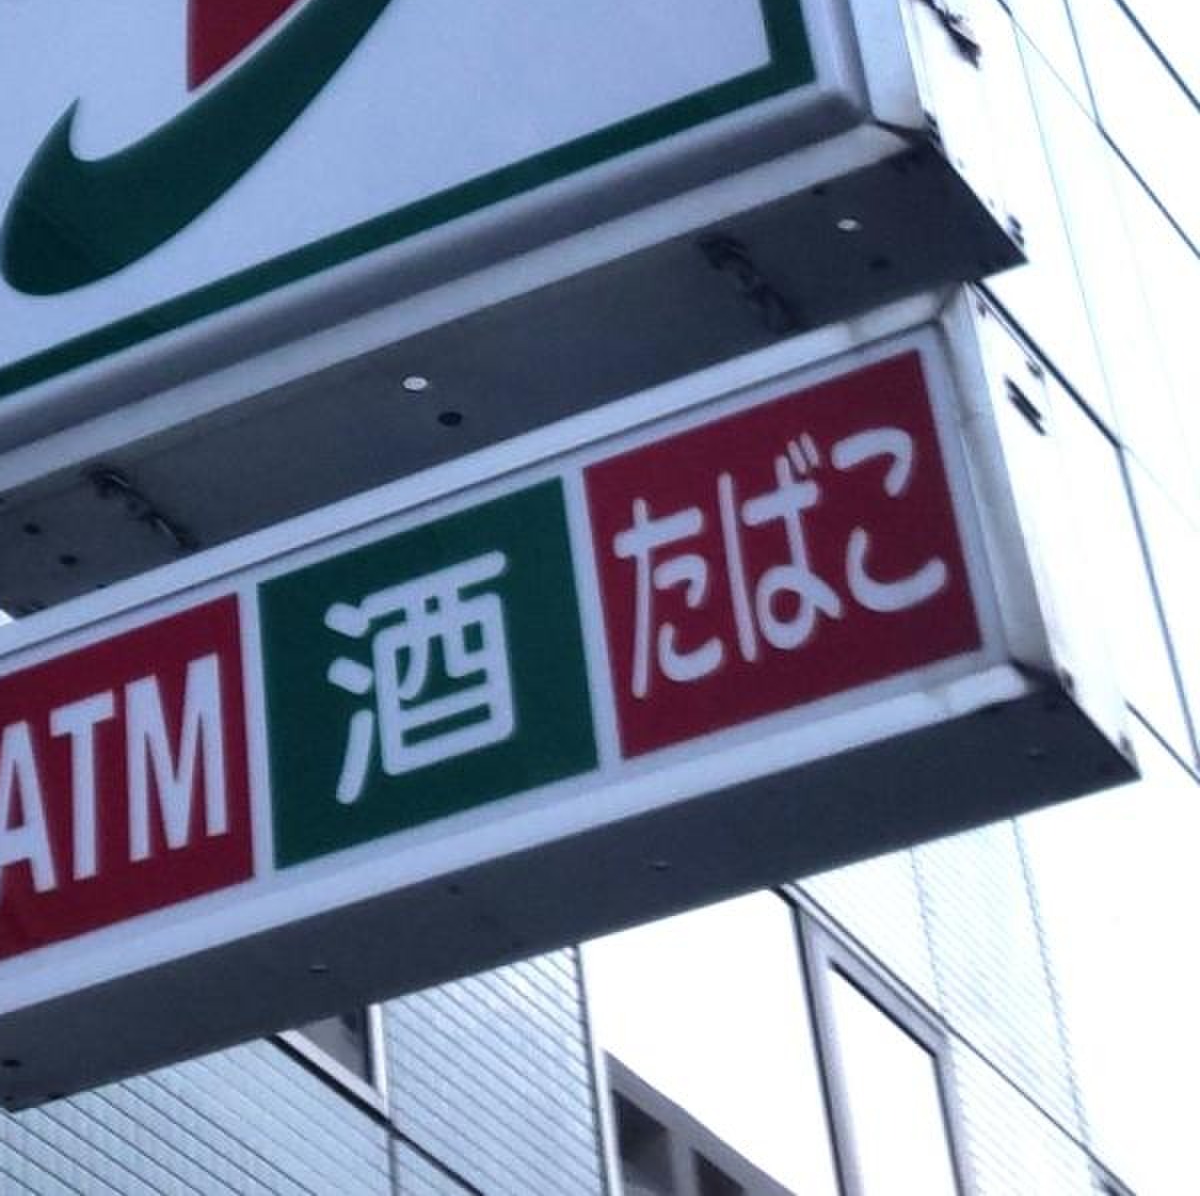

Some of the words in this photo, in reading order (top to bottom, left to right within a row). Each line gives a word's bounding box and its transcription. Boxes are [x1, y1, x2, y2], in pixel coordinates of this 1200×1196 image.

[325, 550, 515, 805] 酒
[613, 429, 947, 698] たばこ
